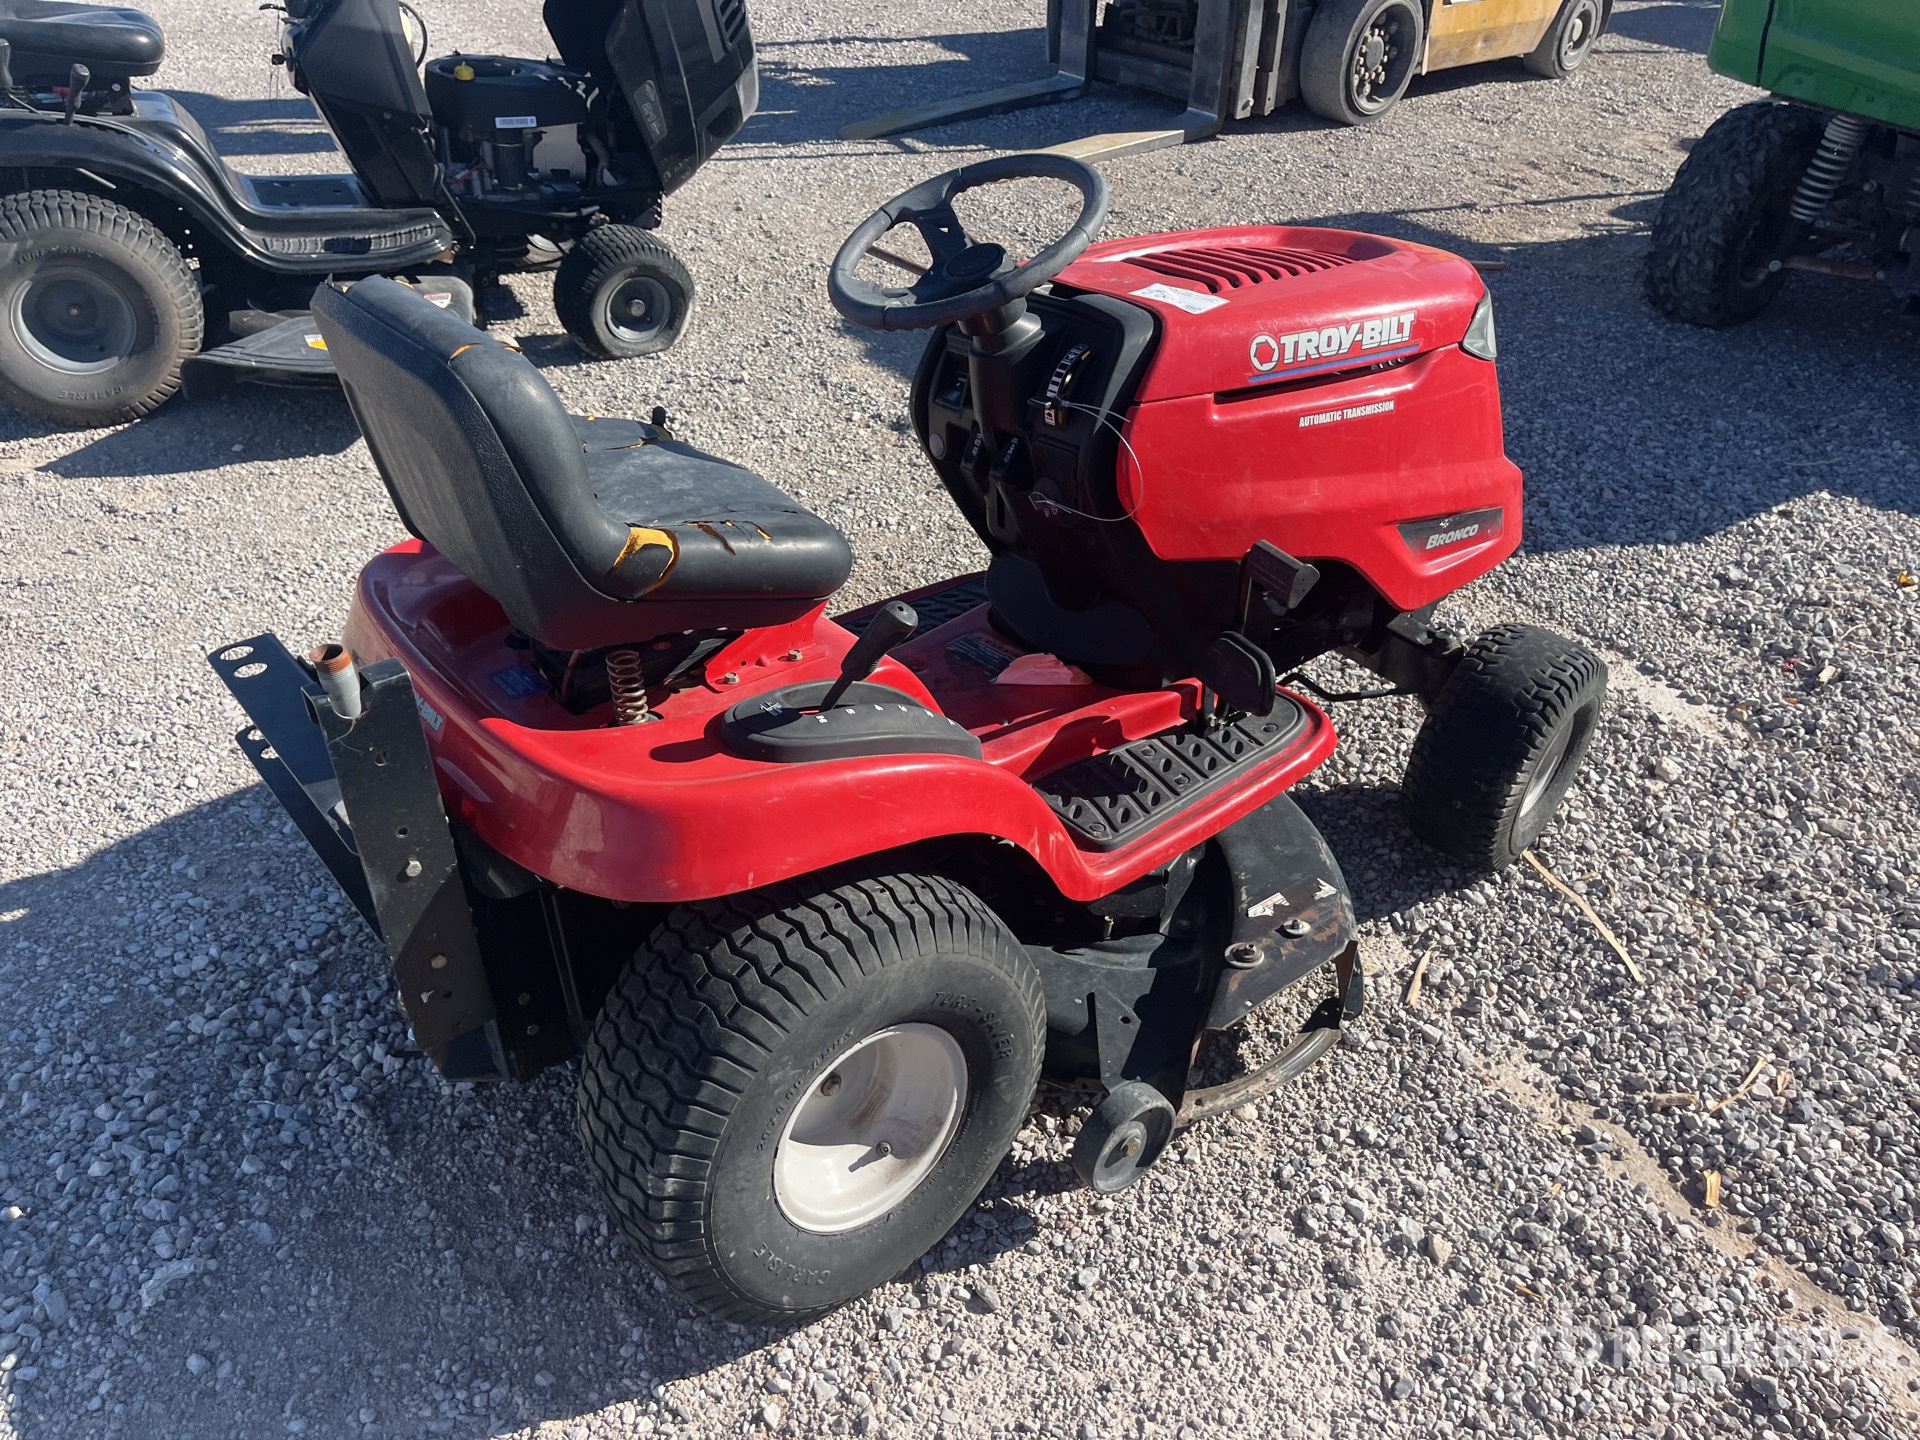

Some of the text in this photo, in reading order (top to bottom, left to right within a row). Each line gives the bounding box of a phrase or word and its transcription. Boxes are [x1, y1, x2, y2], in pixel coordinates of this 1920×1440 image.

[1280, 313, 1415, 364] TROY-BILT
[59, 384, 123, 401] CARLISLE
[1299, 400, 1395, 428] AUTOMATIC TRANSMISSION
[1426, 523, 1479, 550] BRONCO
[753, 1241, 831, 1285] CARLISLE
